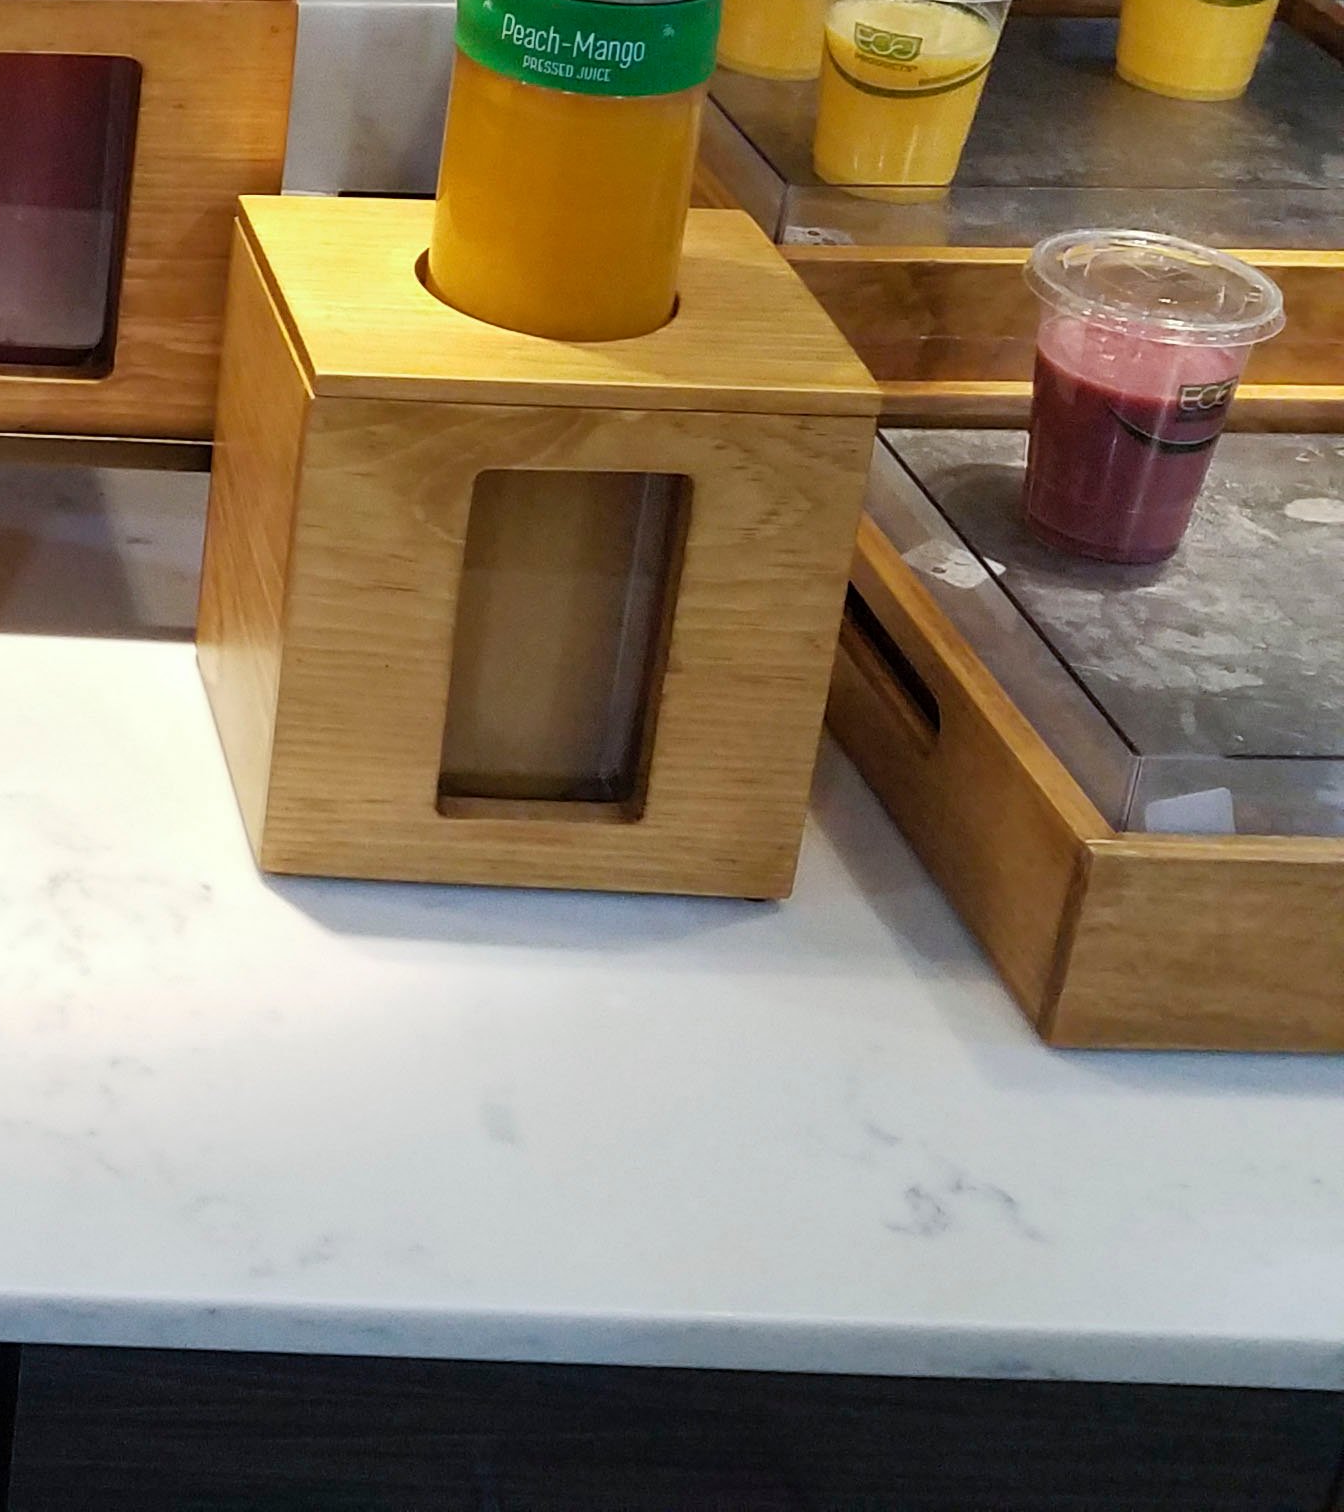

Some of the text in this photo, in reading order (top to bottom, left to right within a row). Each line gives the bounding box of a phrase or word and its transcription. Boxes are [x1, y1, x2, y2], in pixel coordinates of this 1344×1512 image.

[502, 13, 645, 68] Peach-Mango
[522, 55, 611, 82] PRESSED JUICE
